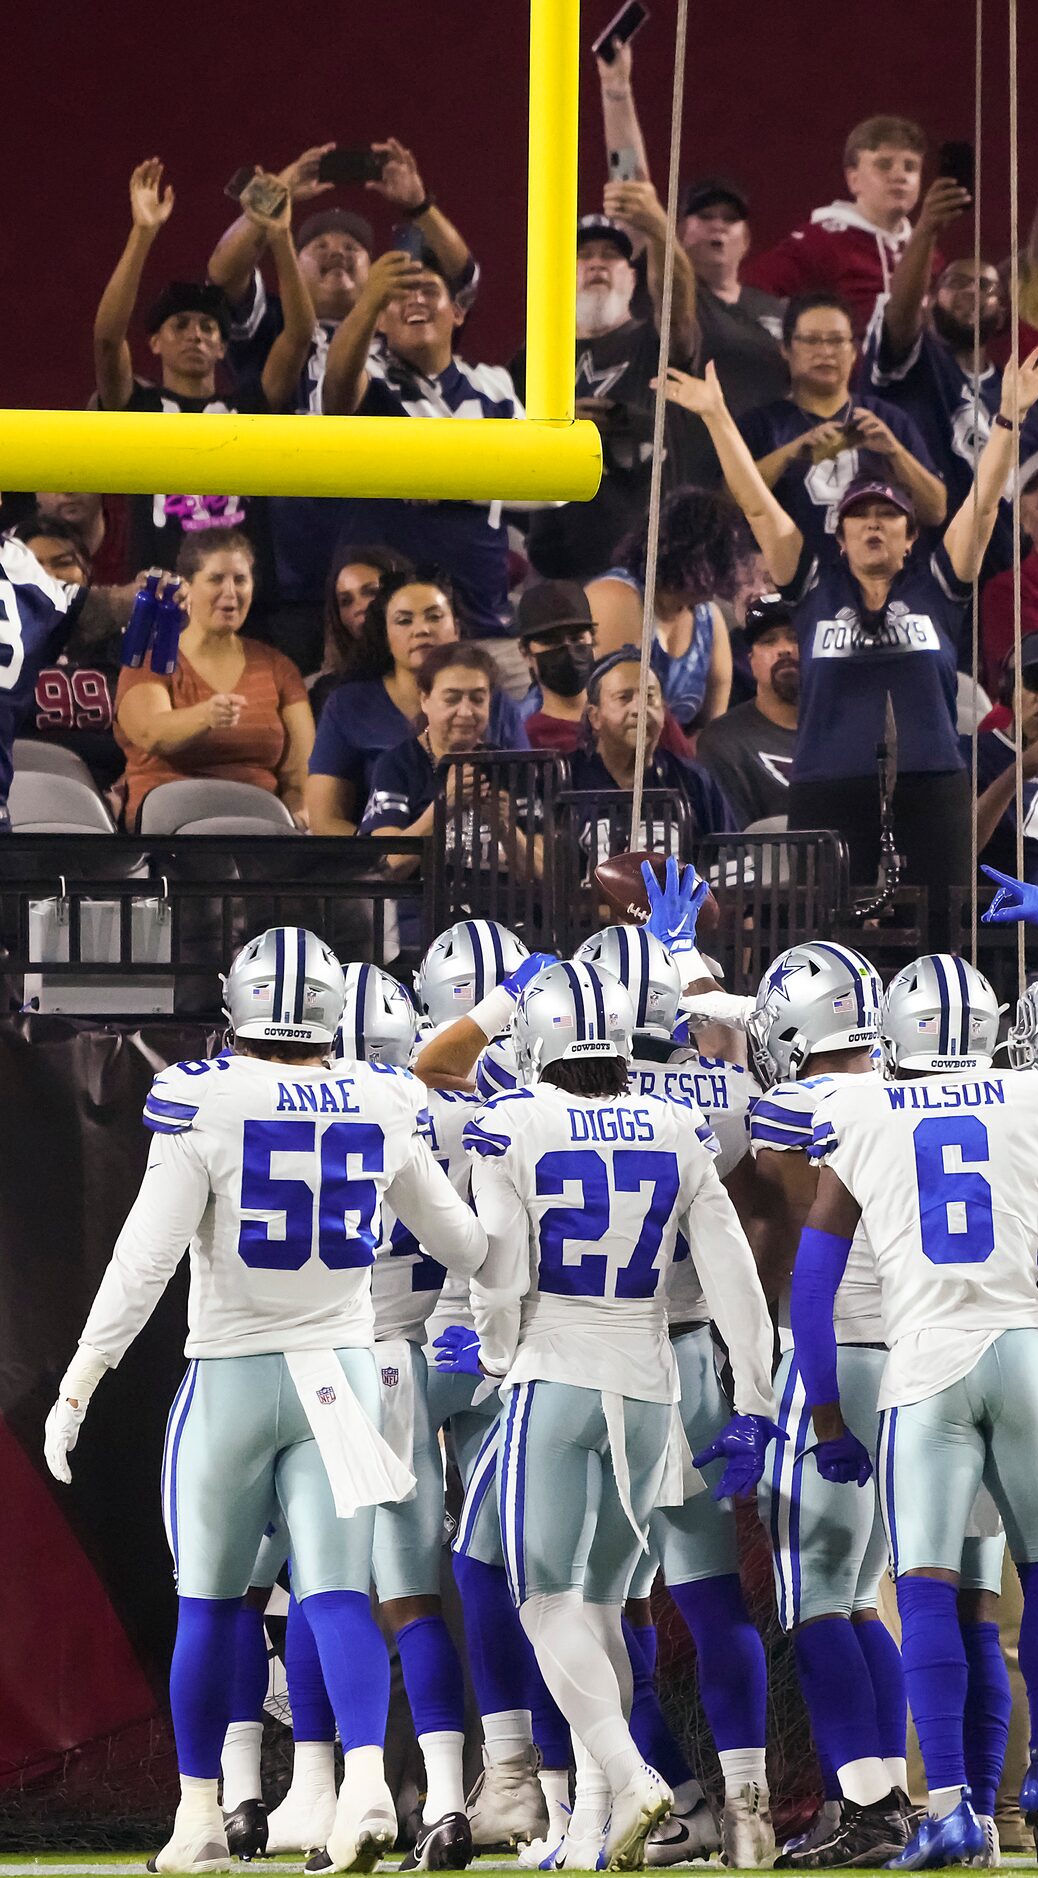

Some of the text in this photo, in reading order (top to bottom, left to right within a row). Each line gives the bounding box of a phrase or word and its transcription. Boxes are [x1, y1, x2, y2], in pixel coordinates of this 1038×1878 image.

[35, 670, 112, 729] 99
[264, 1027, 312, 1039] COWBOYS
[571, 1043, 611, 1053] COWBOYS
[931, 1059, 977, 1068] COWBOYS
[276, 1078, 360, 1114] ANAE
[884, 1079, 1005, 1110] WILSON
[567, 1108, 654, 1142] DIGGS
[238, 1119, 385, 1271] 56
[913, 1114, 995, 1264] 6
[535, 1150, 681, 1298] 27
